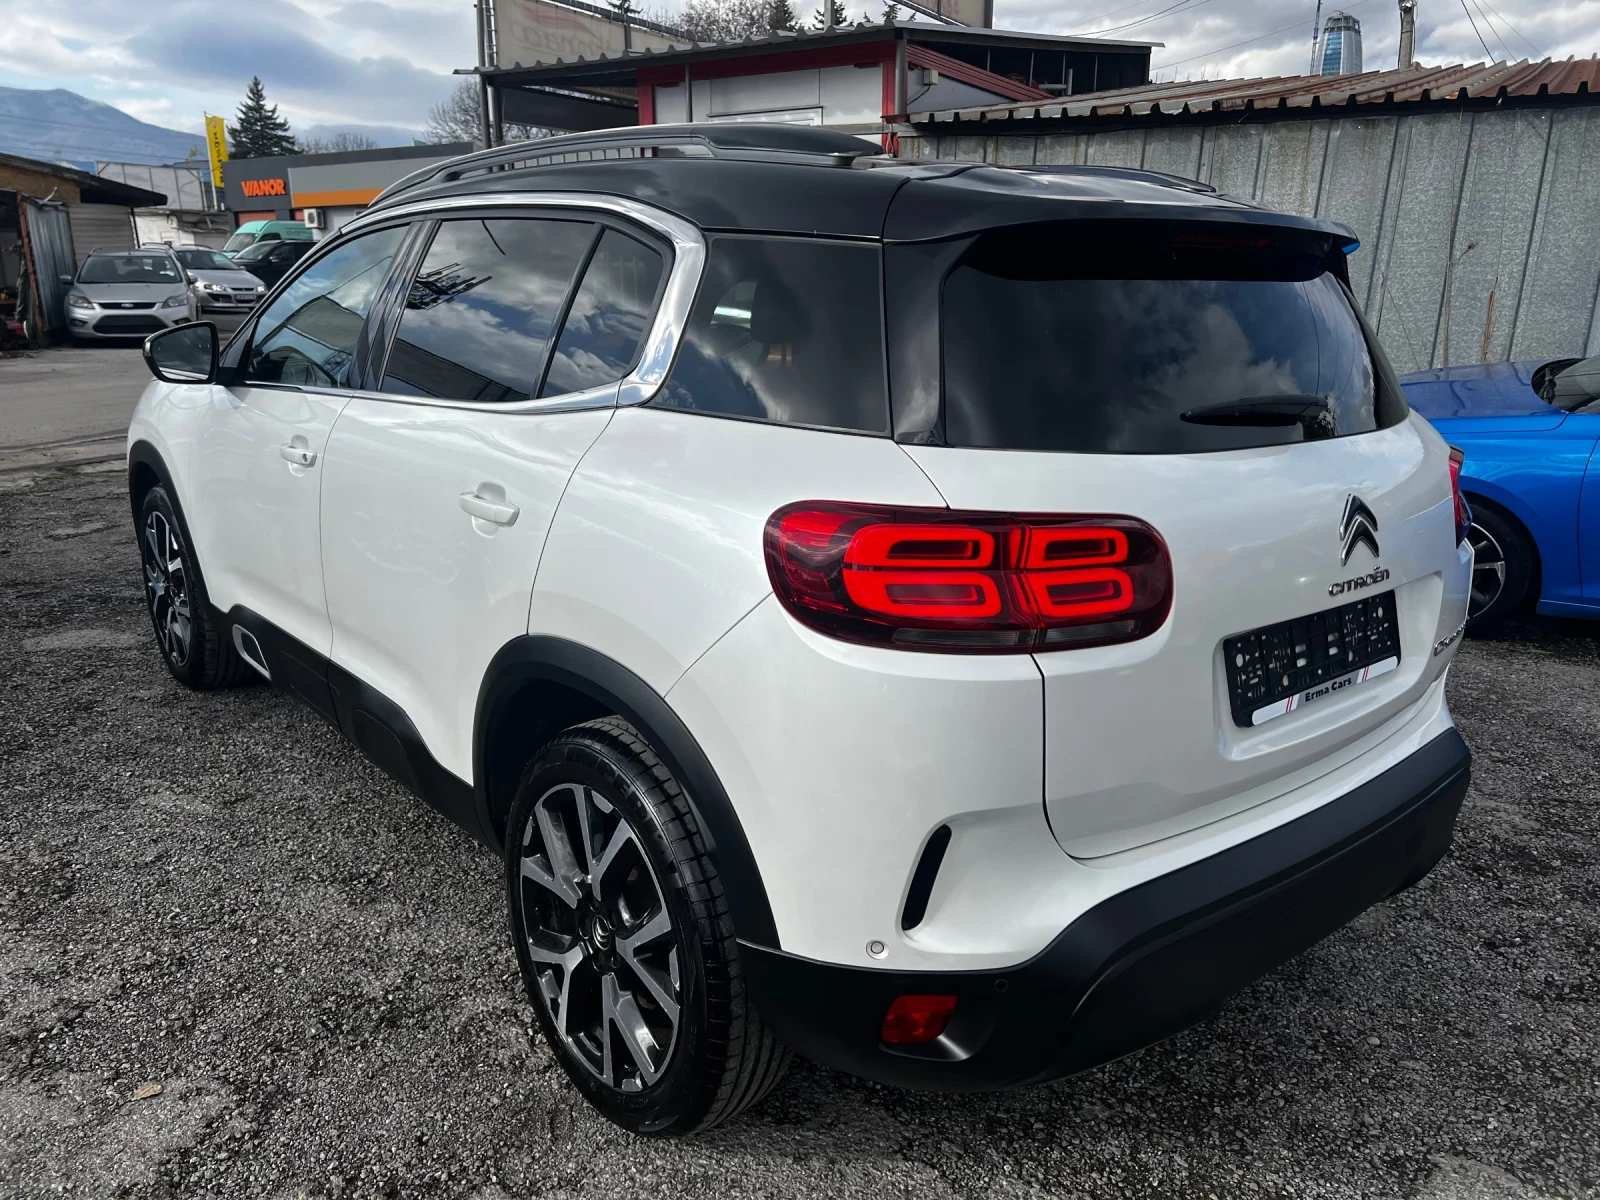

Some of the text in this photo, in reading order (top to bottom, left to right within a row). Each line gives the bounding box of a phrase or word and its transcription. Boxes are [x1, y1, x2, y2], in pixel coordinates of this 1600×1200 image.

[241, 179, 286, 197] VIANOR
[1305, 677, 1352, 702] Erma Cars
